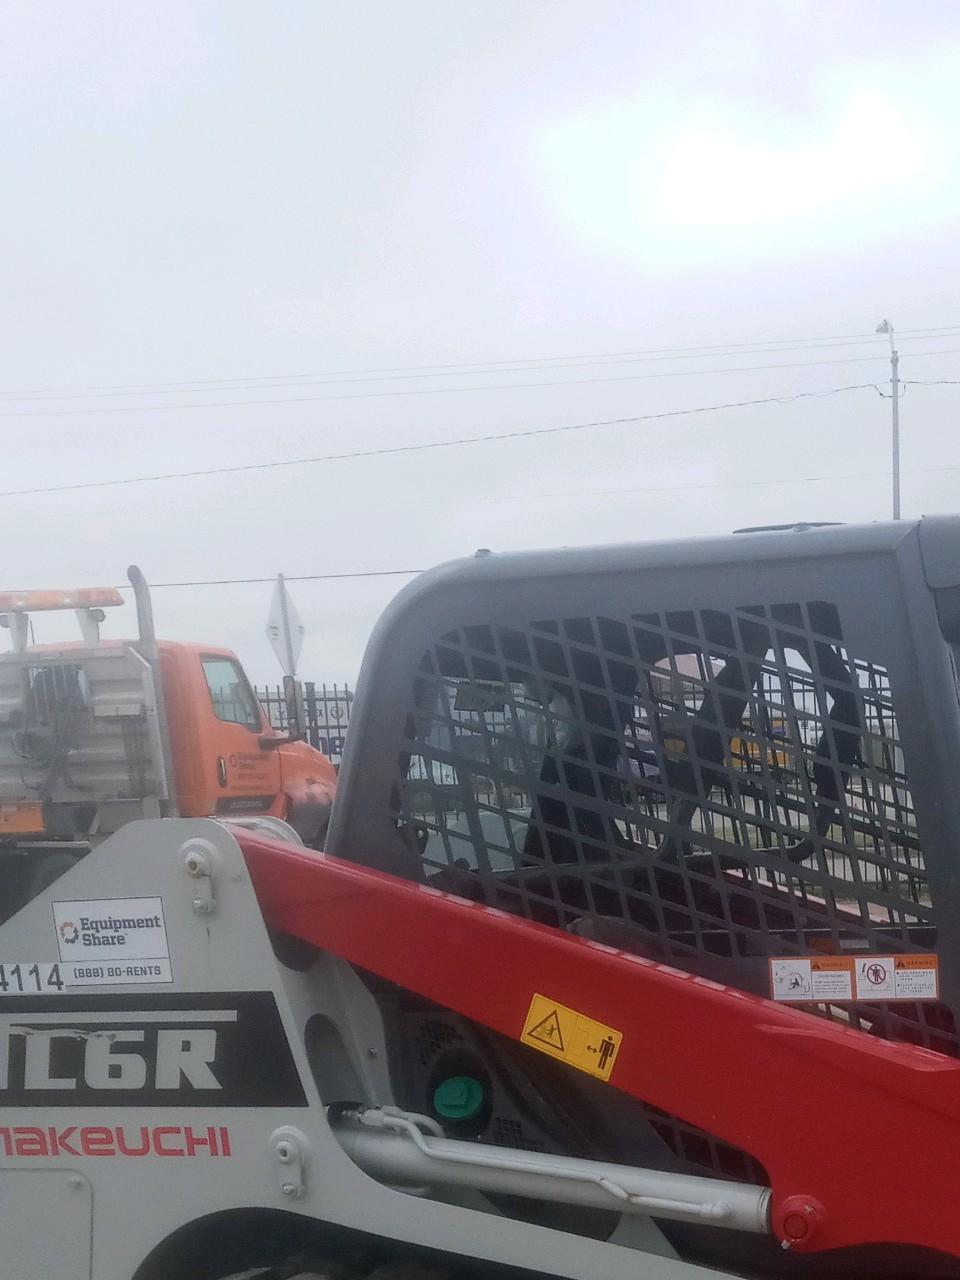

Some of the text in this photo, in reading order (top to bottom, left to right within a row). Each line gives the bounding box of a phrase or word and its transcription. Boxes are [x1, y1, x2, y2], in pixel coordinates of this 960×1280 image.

[80, 914, 161, 932] Equipment
[82, 932, 126, 946] Share
[73, 965, 162, 979] (888) 80-RENTS
